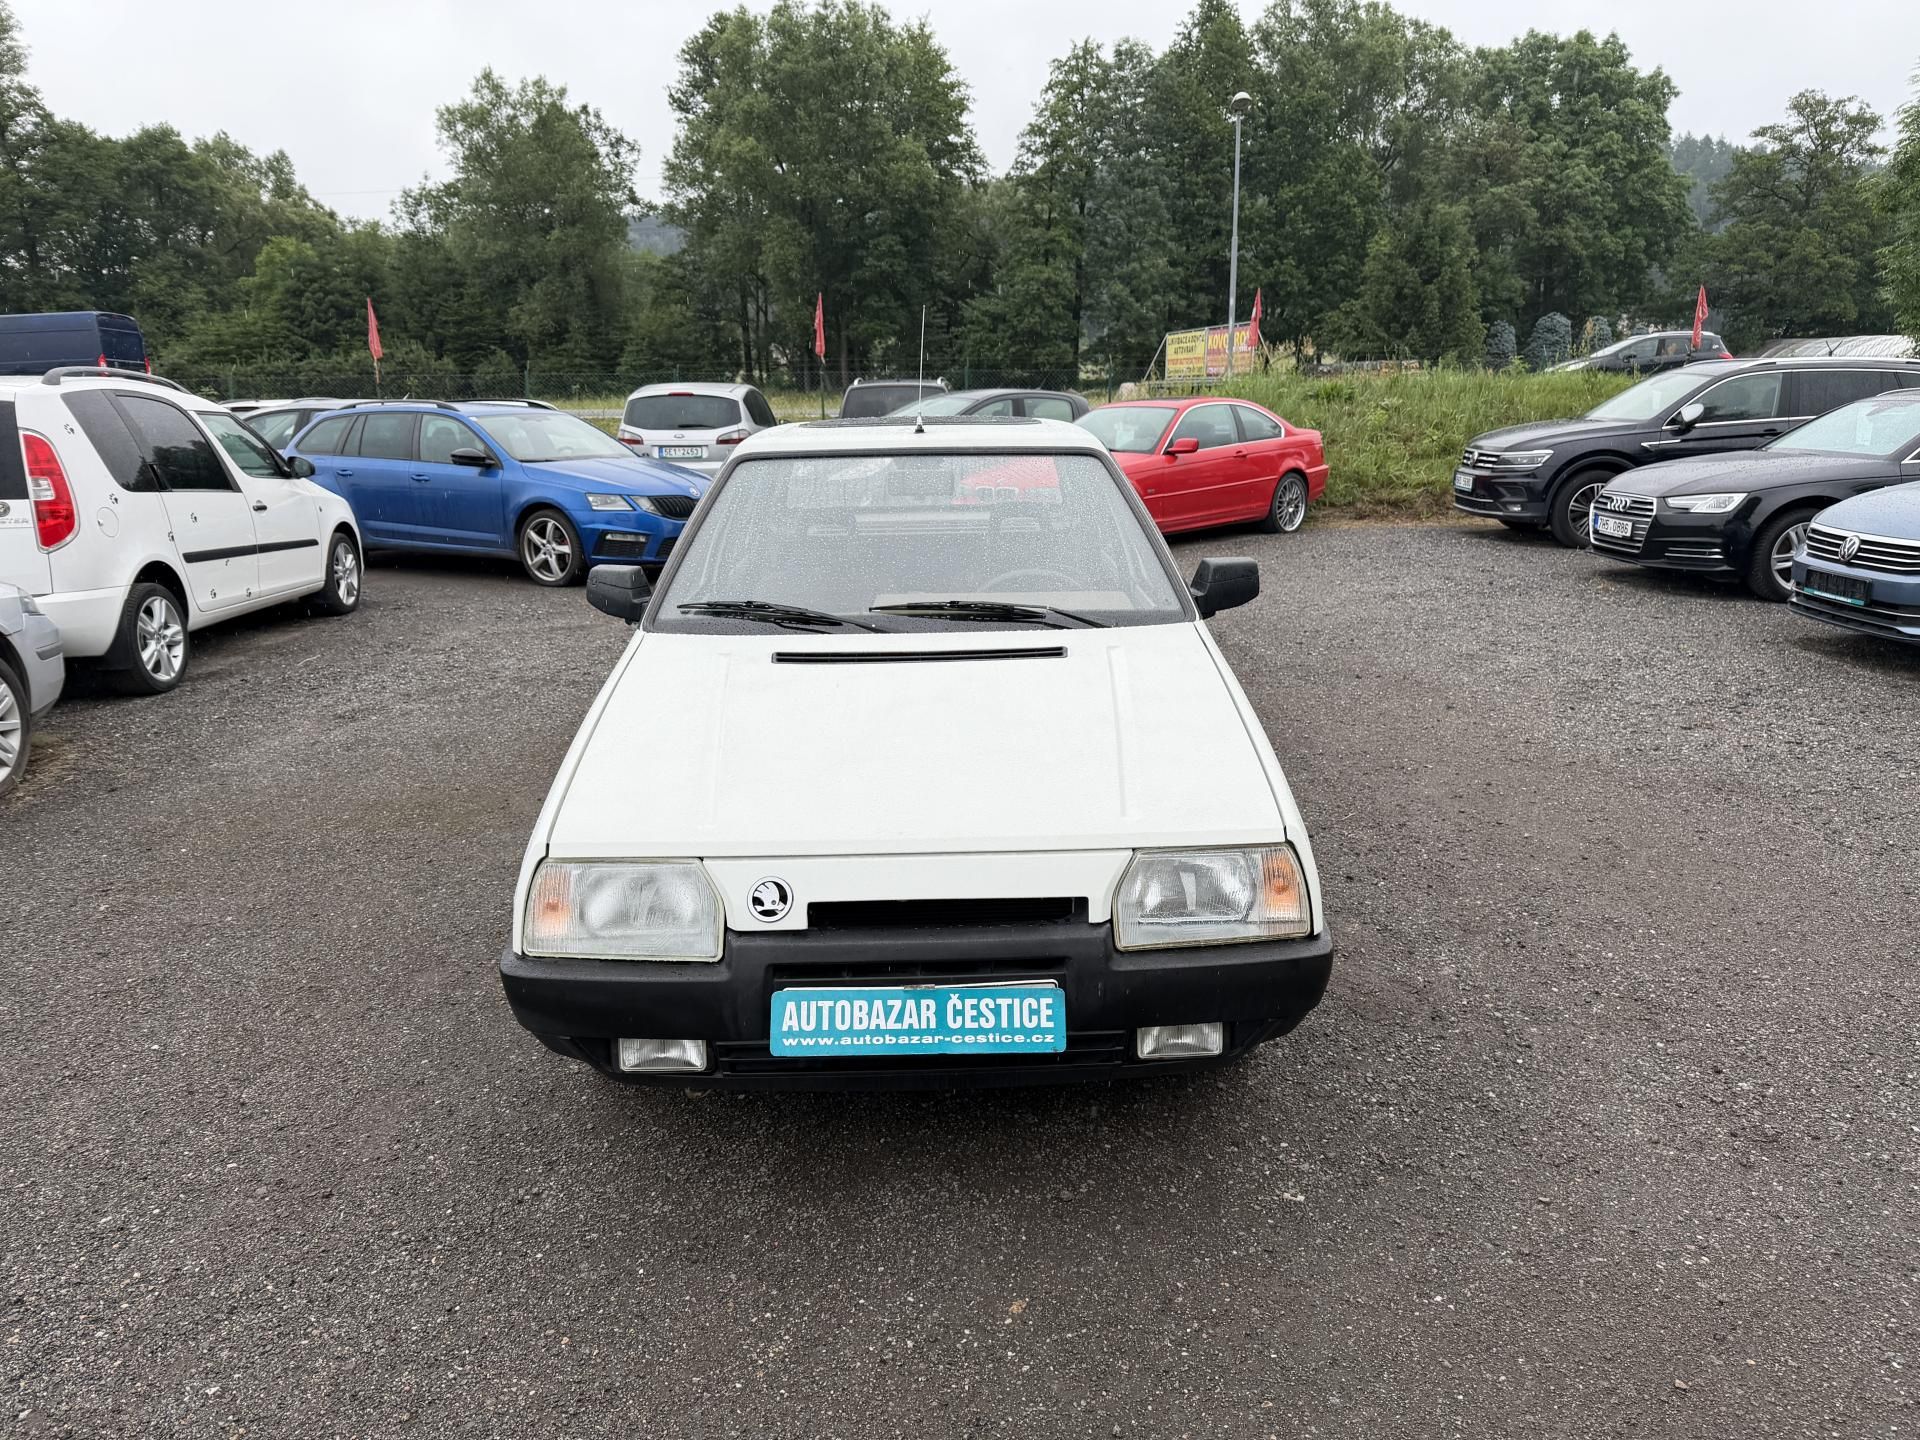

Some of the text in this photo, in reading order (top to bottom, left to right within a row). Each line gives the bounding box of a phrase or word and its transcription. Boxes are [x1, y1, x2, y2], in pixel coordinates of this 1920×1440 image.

[781, 993, 1054, 1032] AUTOBAZAR ČESTICE
[781, 1032, 1055, 1046] www.autobazar-cestice.cz
